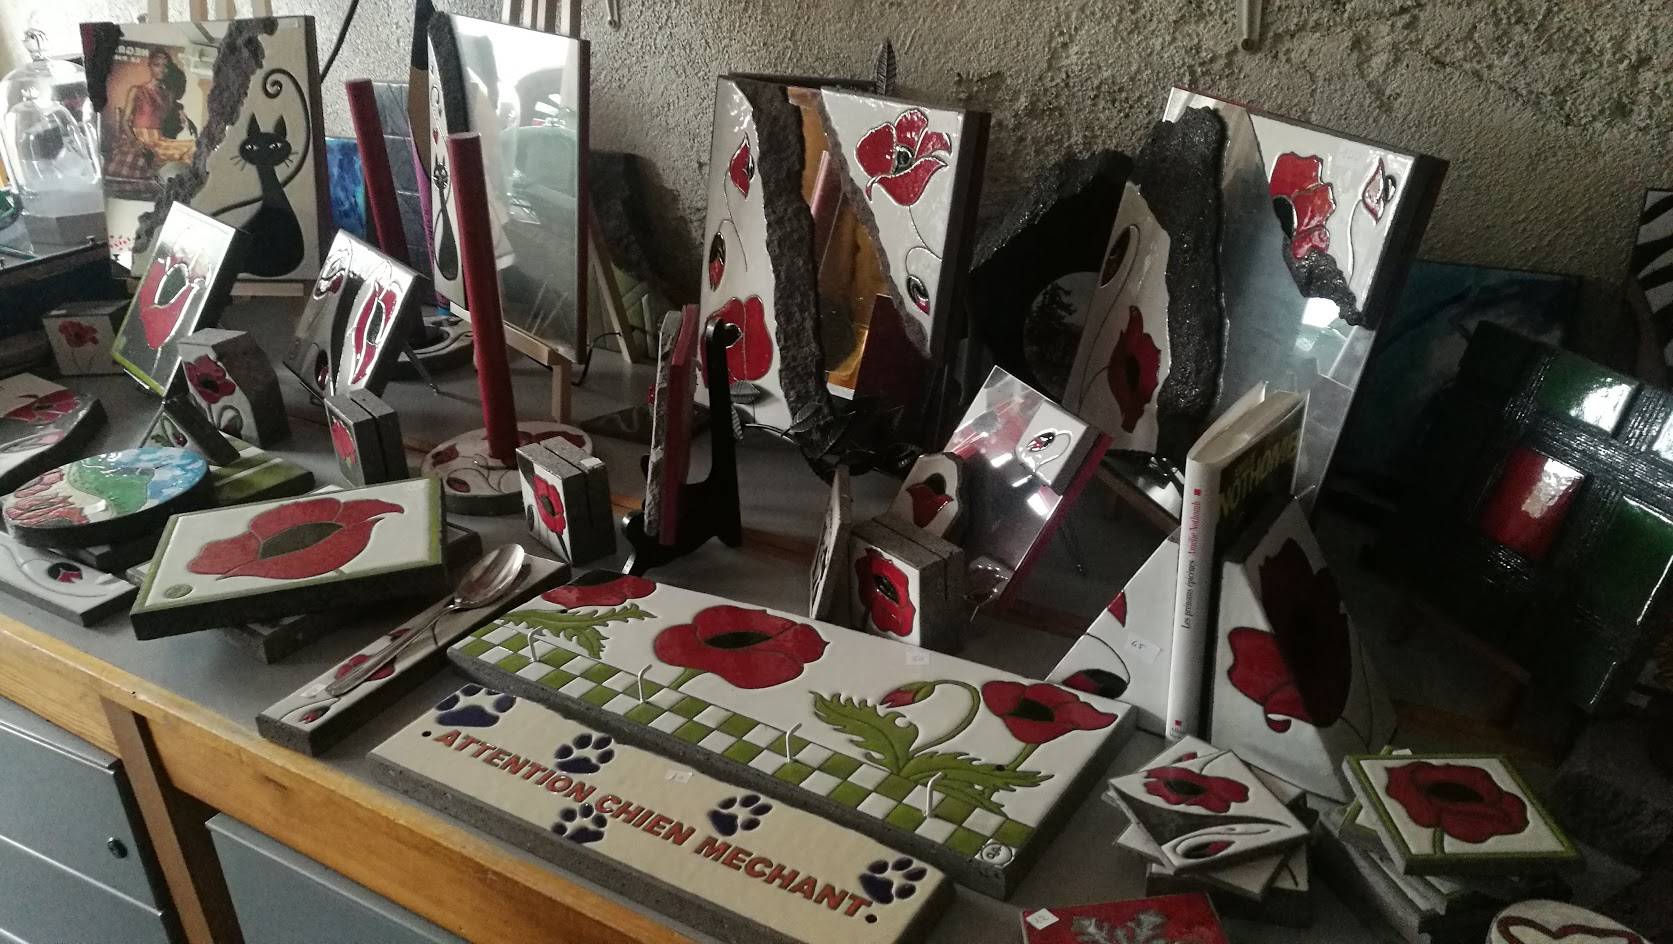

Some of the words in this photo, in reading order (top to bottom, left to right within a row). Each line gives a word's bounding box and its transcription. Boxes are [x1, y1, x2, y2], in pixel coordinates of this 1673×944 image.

[1181, 617, 1191, 629] Les
[433, 729, 597, 803] ATTENTION
[594, 794, 697, 846] CHIEN
[693, 835, 873, 917] MECHANT
